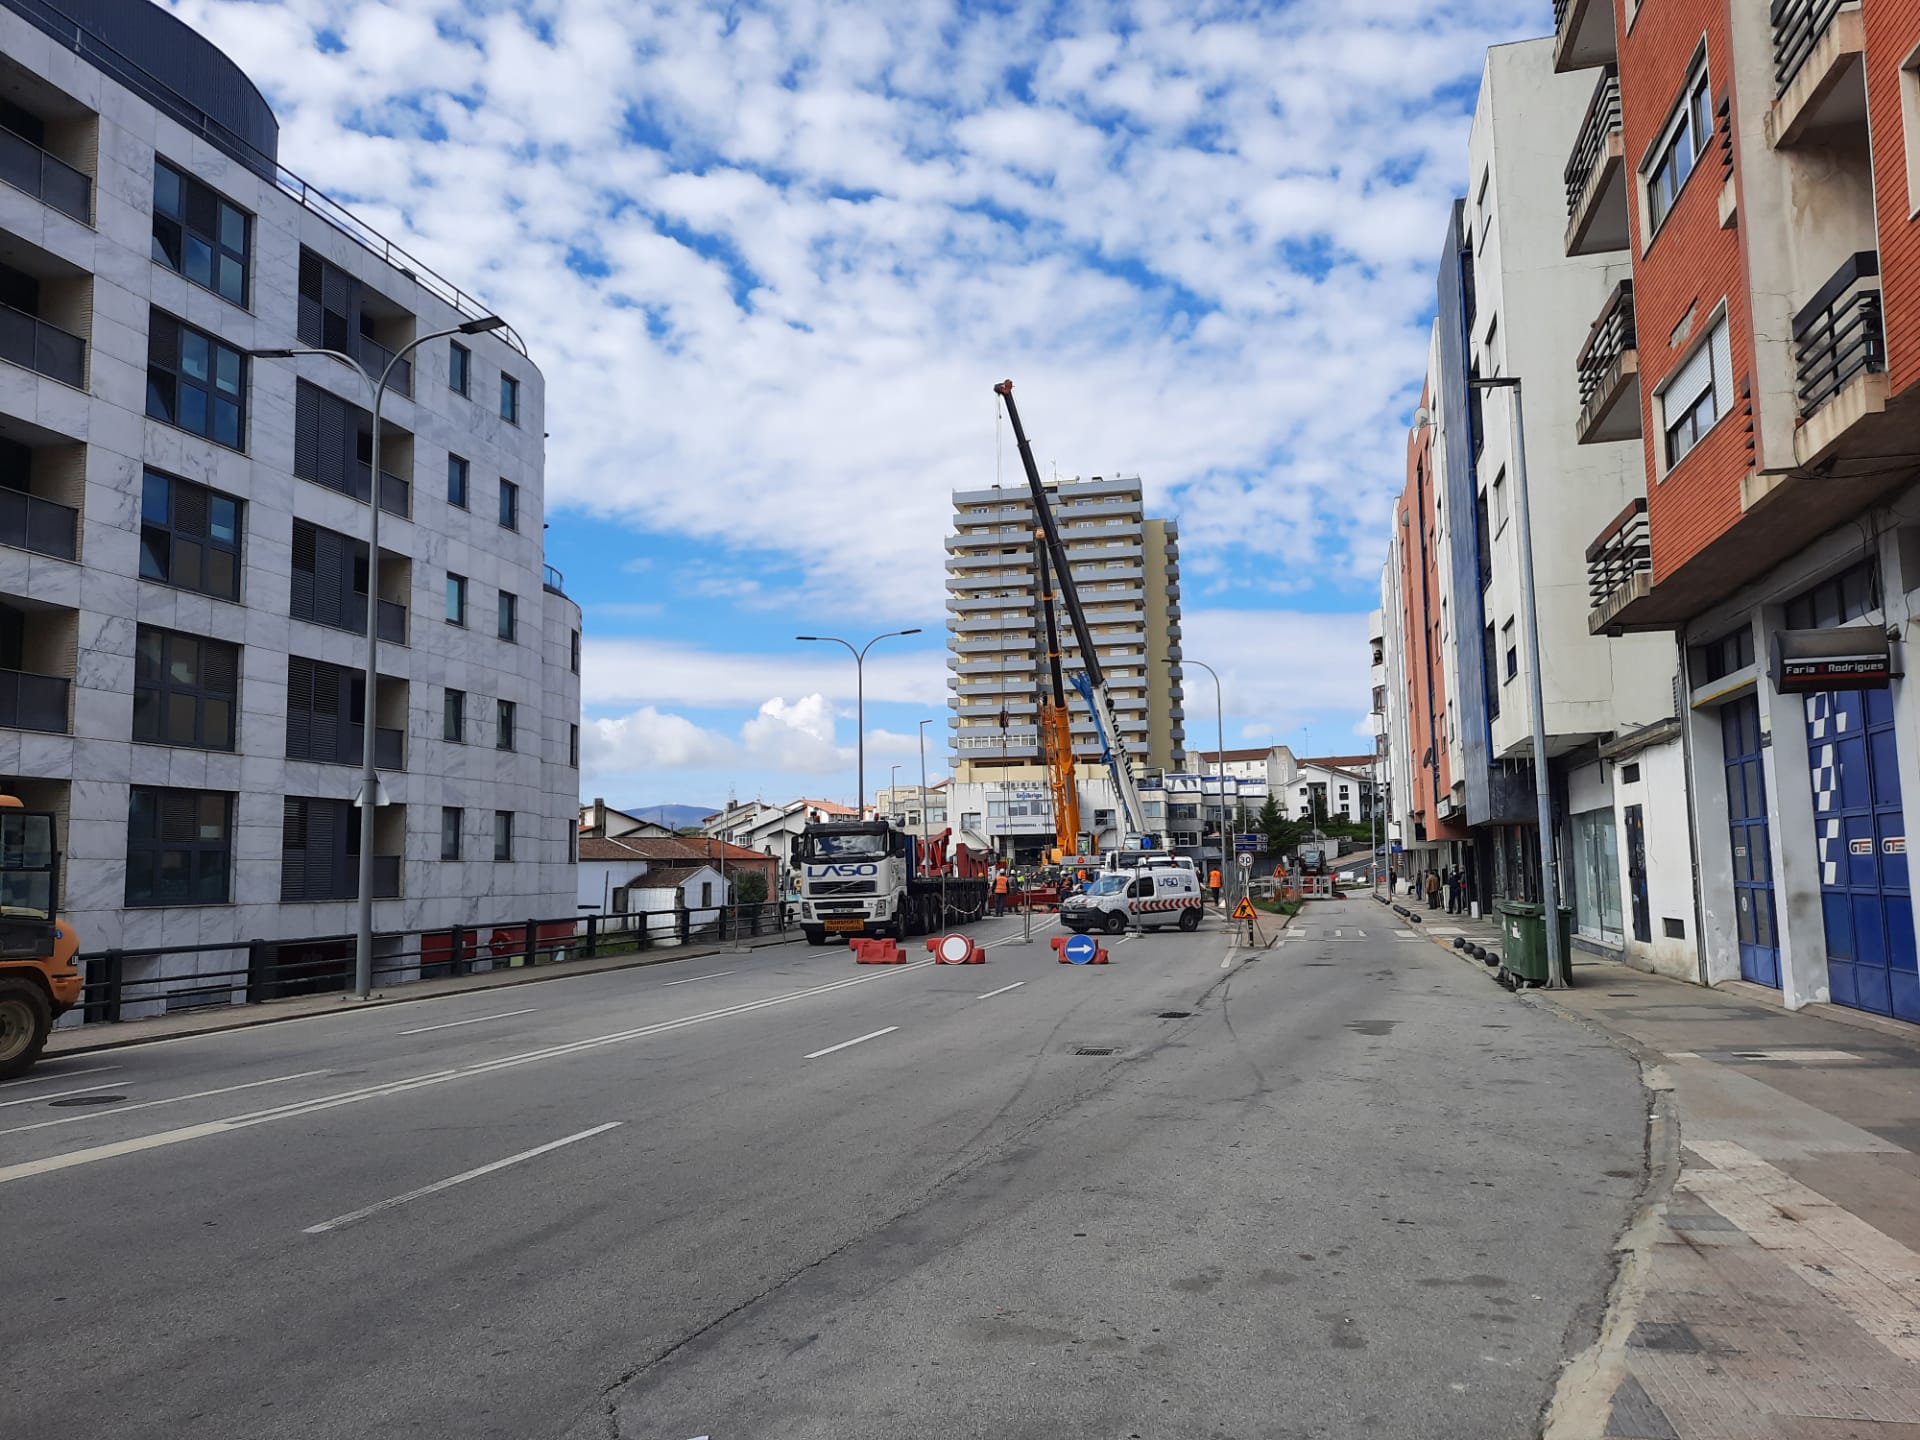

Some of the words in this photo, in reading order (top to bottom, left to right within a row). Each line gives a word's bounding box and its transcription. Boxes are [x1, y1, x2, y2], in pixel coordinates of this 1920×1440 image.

[1786, 666, 1815, 674] Faria
[1828, 663, 1884, 673] Rodrigues
[808, 864, 877, 877] LASO
